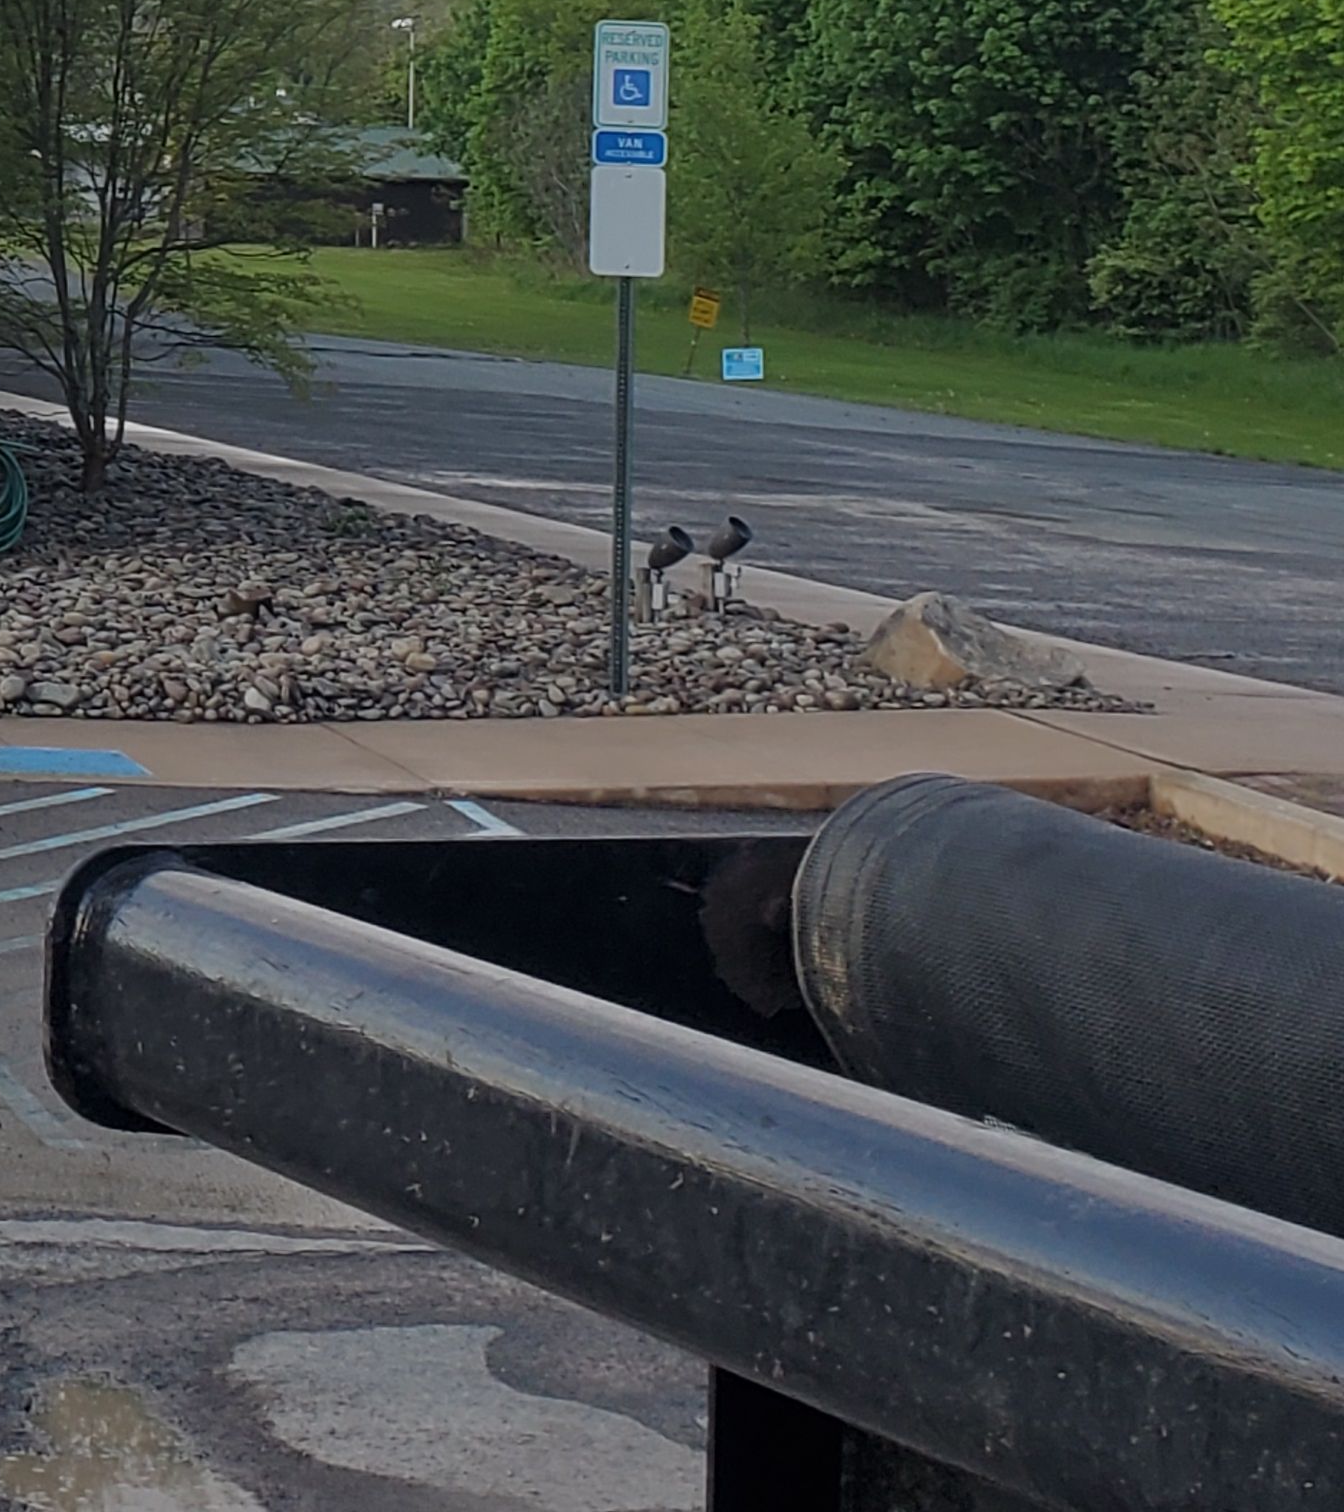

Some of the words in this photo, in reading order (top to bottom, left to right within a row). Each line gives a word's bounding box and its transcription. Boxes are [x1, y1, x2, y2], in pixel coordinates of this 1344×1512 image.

[602, 32, 662, 47] RESERVED
[605, 50, 659, 66] PARKING
[617, 138, 643, 148] VAN
